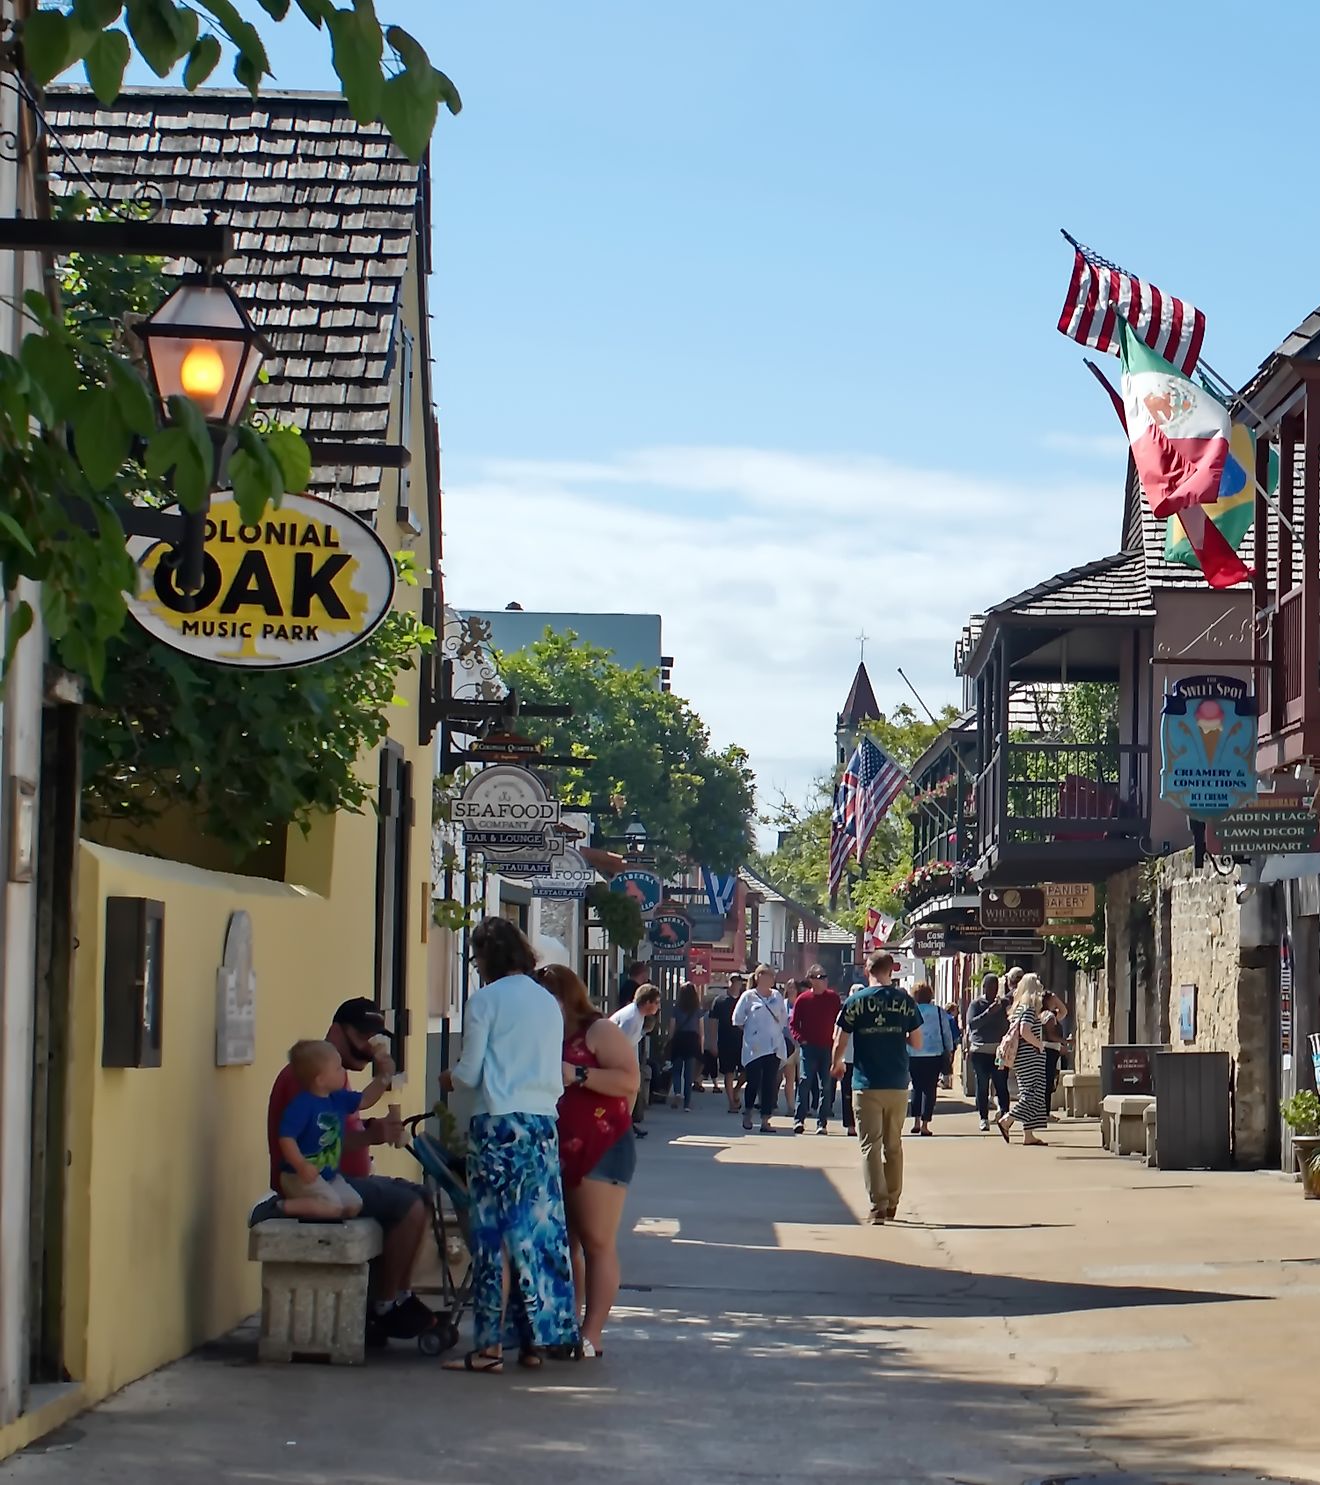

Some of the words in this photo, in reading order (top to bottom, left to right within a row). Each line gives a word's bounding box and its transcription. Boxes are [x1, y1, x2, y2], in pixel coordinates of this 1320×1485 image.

[204, 519, 340, 548] OLONIAL
[153, 549, 352, 619] OAK
[182, 620, 252, 638] MUSIC
[263, 622, 319, 642] PARK
[1174, 769, 1231, 777] CREAMERY
[1173, 779, 1247, 788] CONFECTIONS
[1204, 793, 1228, 801] CREAM
[455, 803, 554, 819] SEAFOOD
[1221, 812, 1271, 822] ARDEN
[479, 820, 528, 829] COMPANY
[1223, 829, 1260, 837] LAWN
[1263, 827, 1305, 836] DECOR
[467, 834, 487, 842] BAR
[500, 835, 541, 843] LOUNGE
[1230, 842, 1302, 852] ILLUMINART
[487, 863, 550, 872] RSTAURANT
[618, 873, 655, 885] TABERNA
[534, 889, 584, 897] RESTAURANT
[1047, 885, 1089, 896] PANISH
